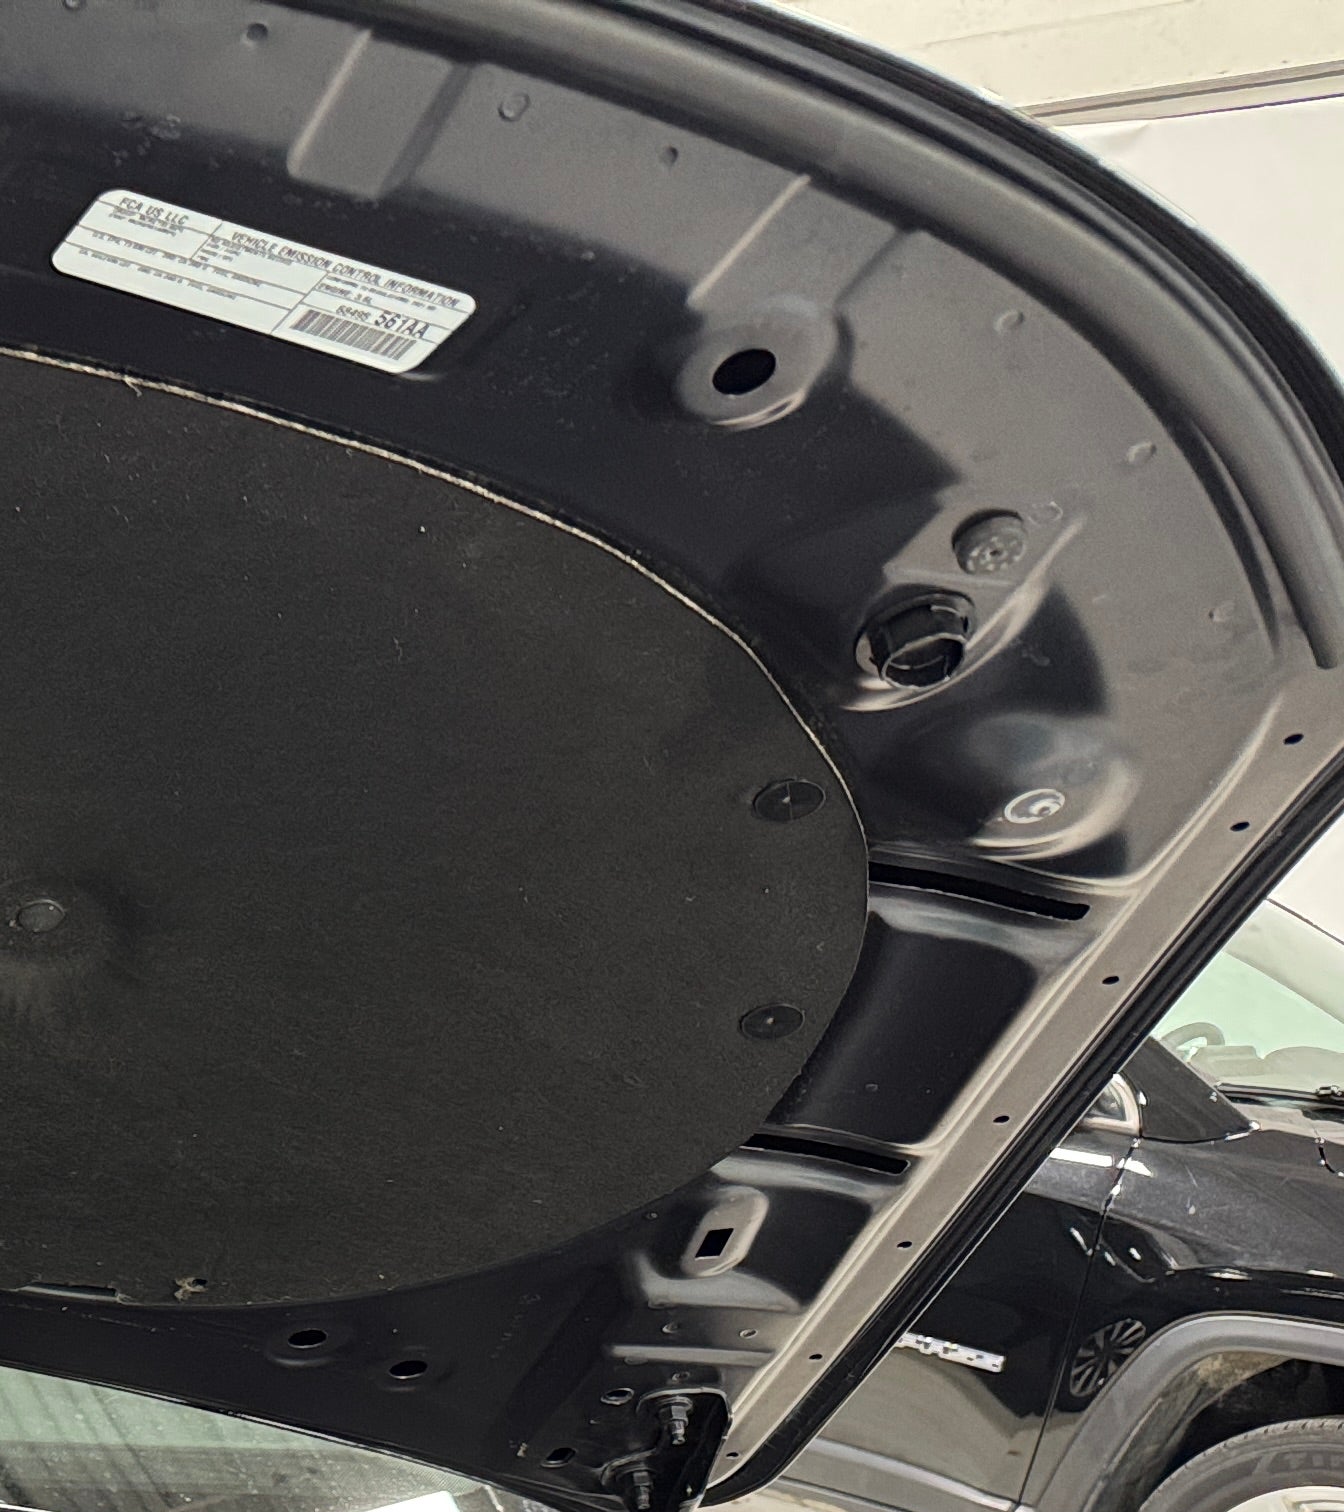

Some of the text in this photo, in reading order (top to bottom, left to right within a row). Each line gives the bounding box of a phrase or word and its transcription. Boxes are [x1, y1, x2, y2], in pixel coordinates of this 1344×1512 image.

[119, 197, 144, 211] FCA
[145, 205, 164, 219] US
[164, 211, 190, 225] LLC
[231, 231, 278, 253] VEHICLE
[278, 245, 332, 269] EMISSION
[332, 262, 382, 285] CONTROL
[383, 277, 461, 308] INFORMATION
[374, 310, 431, 339] 561AA
